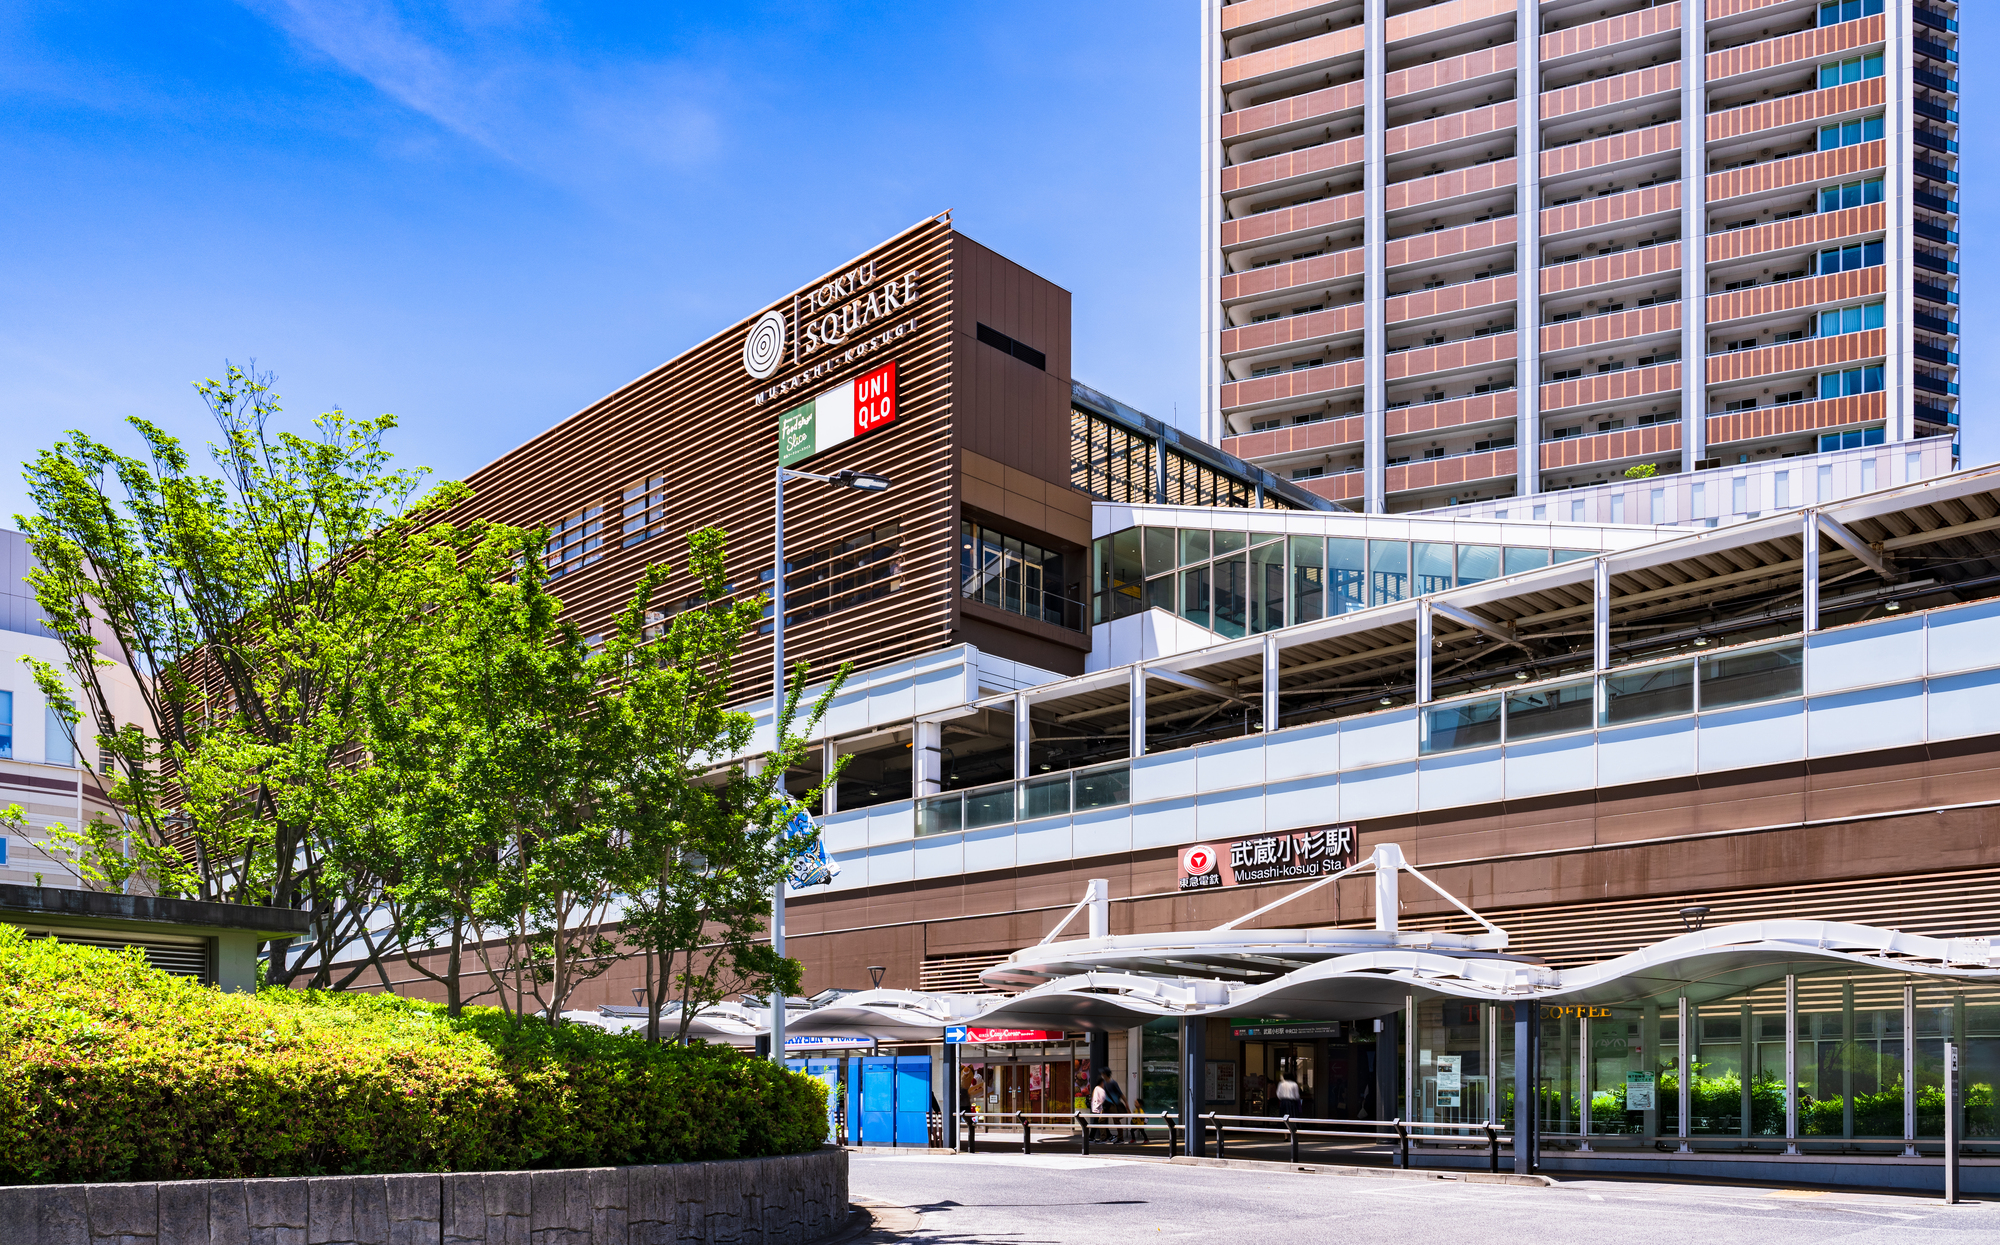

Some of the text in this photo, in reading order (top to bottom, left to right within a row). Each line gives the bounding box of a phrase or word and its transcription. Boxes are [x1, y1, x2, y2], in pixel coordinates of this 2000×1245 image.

[808, 260, 876, 314] TOKYU
[805, 270, 919, 355] SQUARE
[858, 372, 888, 403] UNI
[858, 396, 891, 430] QLO
[786, 433, 807, 452] Slice
[1229, 827, 1352, 868] 武蔵小杉駅
[1179, 874, 1220, 889] 東急電鉄
[1234, 859, 1345, 883] Musashi-kosugi Sta.
[1540, 1004, 1612, 1020] COFFEE
[785, 1036, 823, 1045] AWSON
